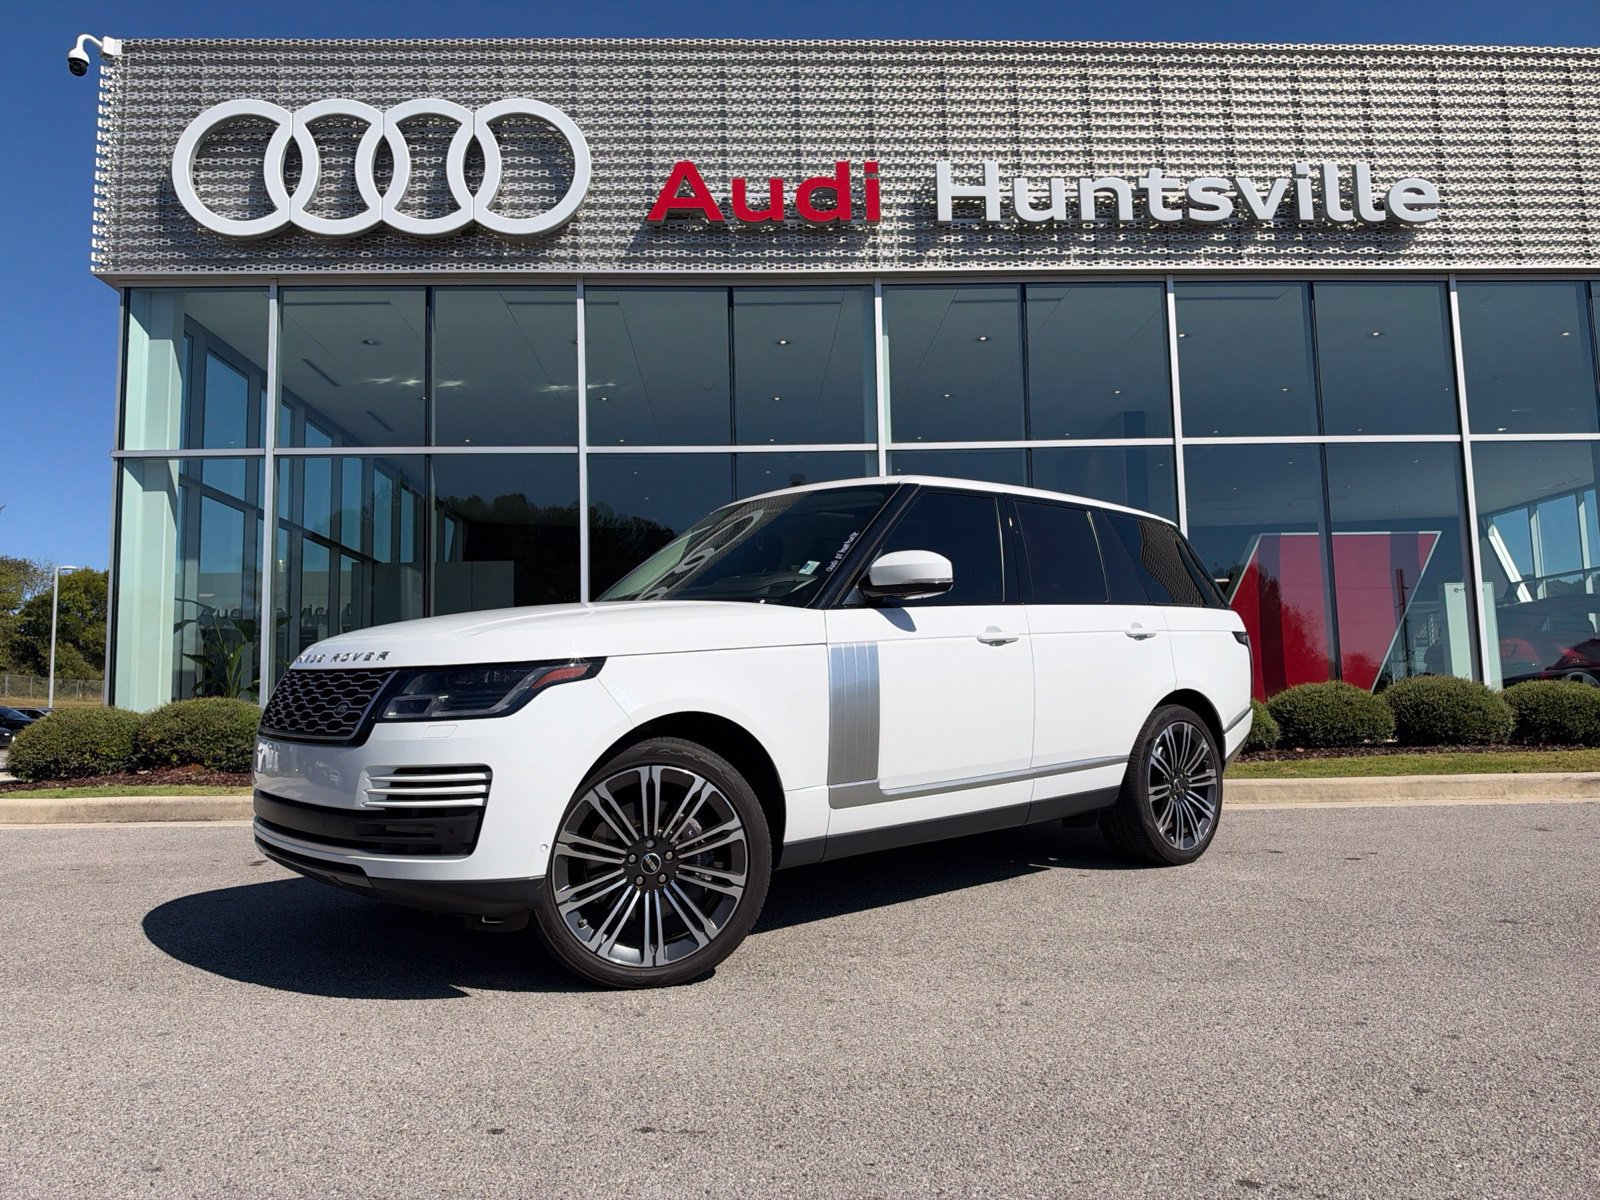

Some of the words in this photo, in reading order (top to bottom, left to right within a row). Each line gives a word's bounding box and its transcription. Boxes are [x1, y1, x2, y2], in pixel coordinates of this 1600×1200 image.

[646, 159, 881, 224] Audi
[935, 159, 1442, 225] Huntsville
[329, 650, 391, 664] ROVER
